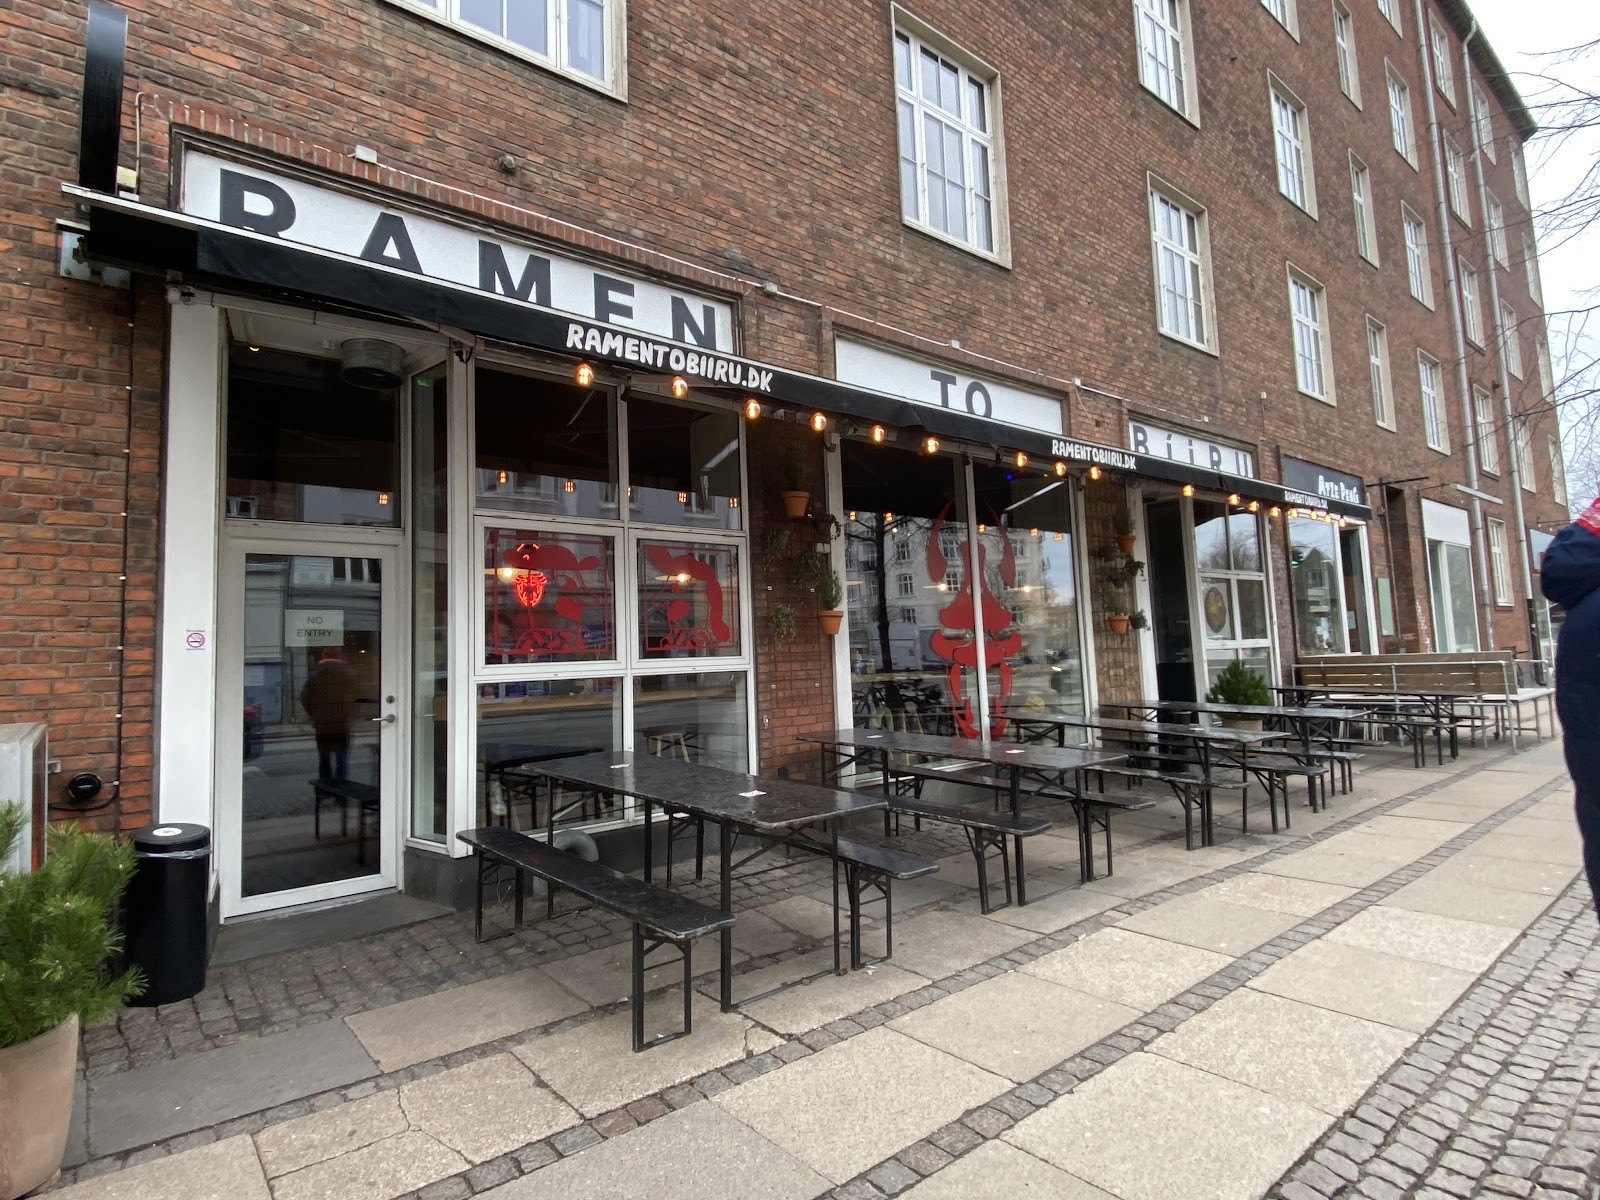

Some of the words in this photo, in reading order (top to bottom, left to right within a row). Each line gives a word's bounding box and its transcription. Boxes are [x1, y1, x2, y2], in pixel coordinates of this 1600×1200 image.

[566, 323, 773, 393] RAMENTOBIIRU.DK
[930, 370, 992, 419] TO
[1051, 439, 1137, 470] RAMENTOBIIRU.DK
[297, 629, 333, 637] ENTRY
[306, 616, 324, 625] NO
